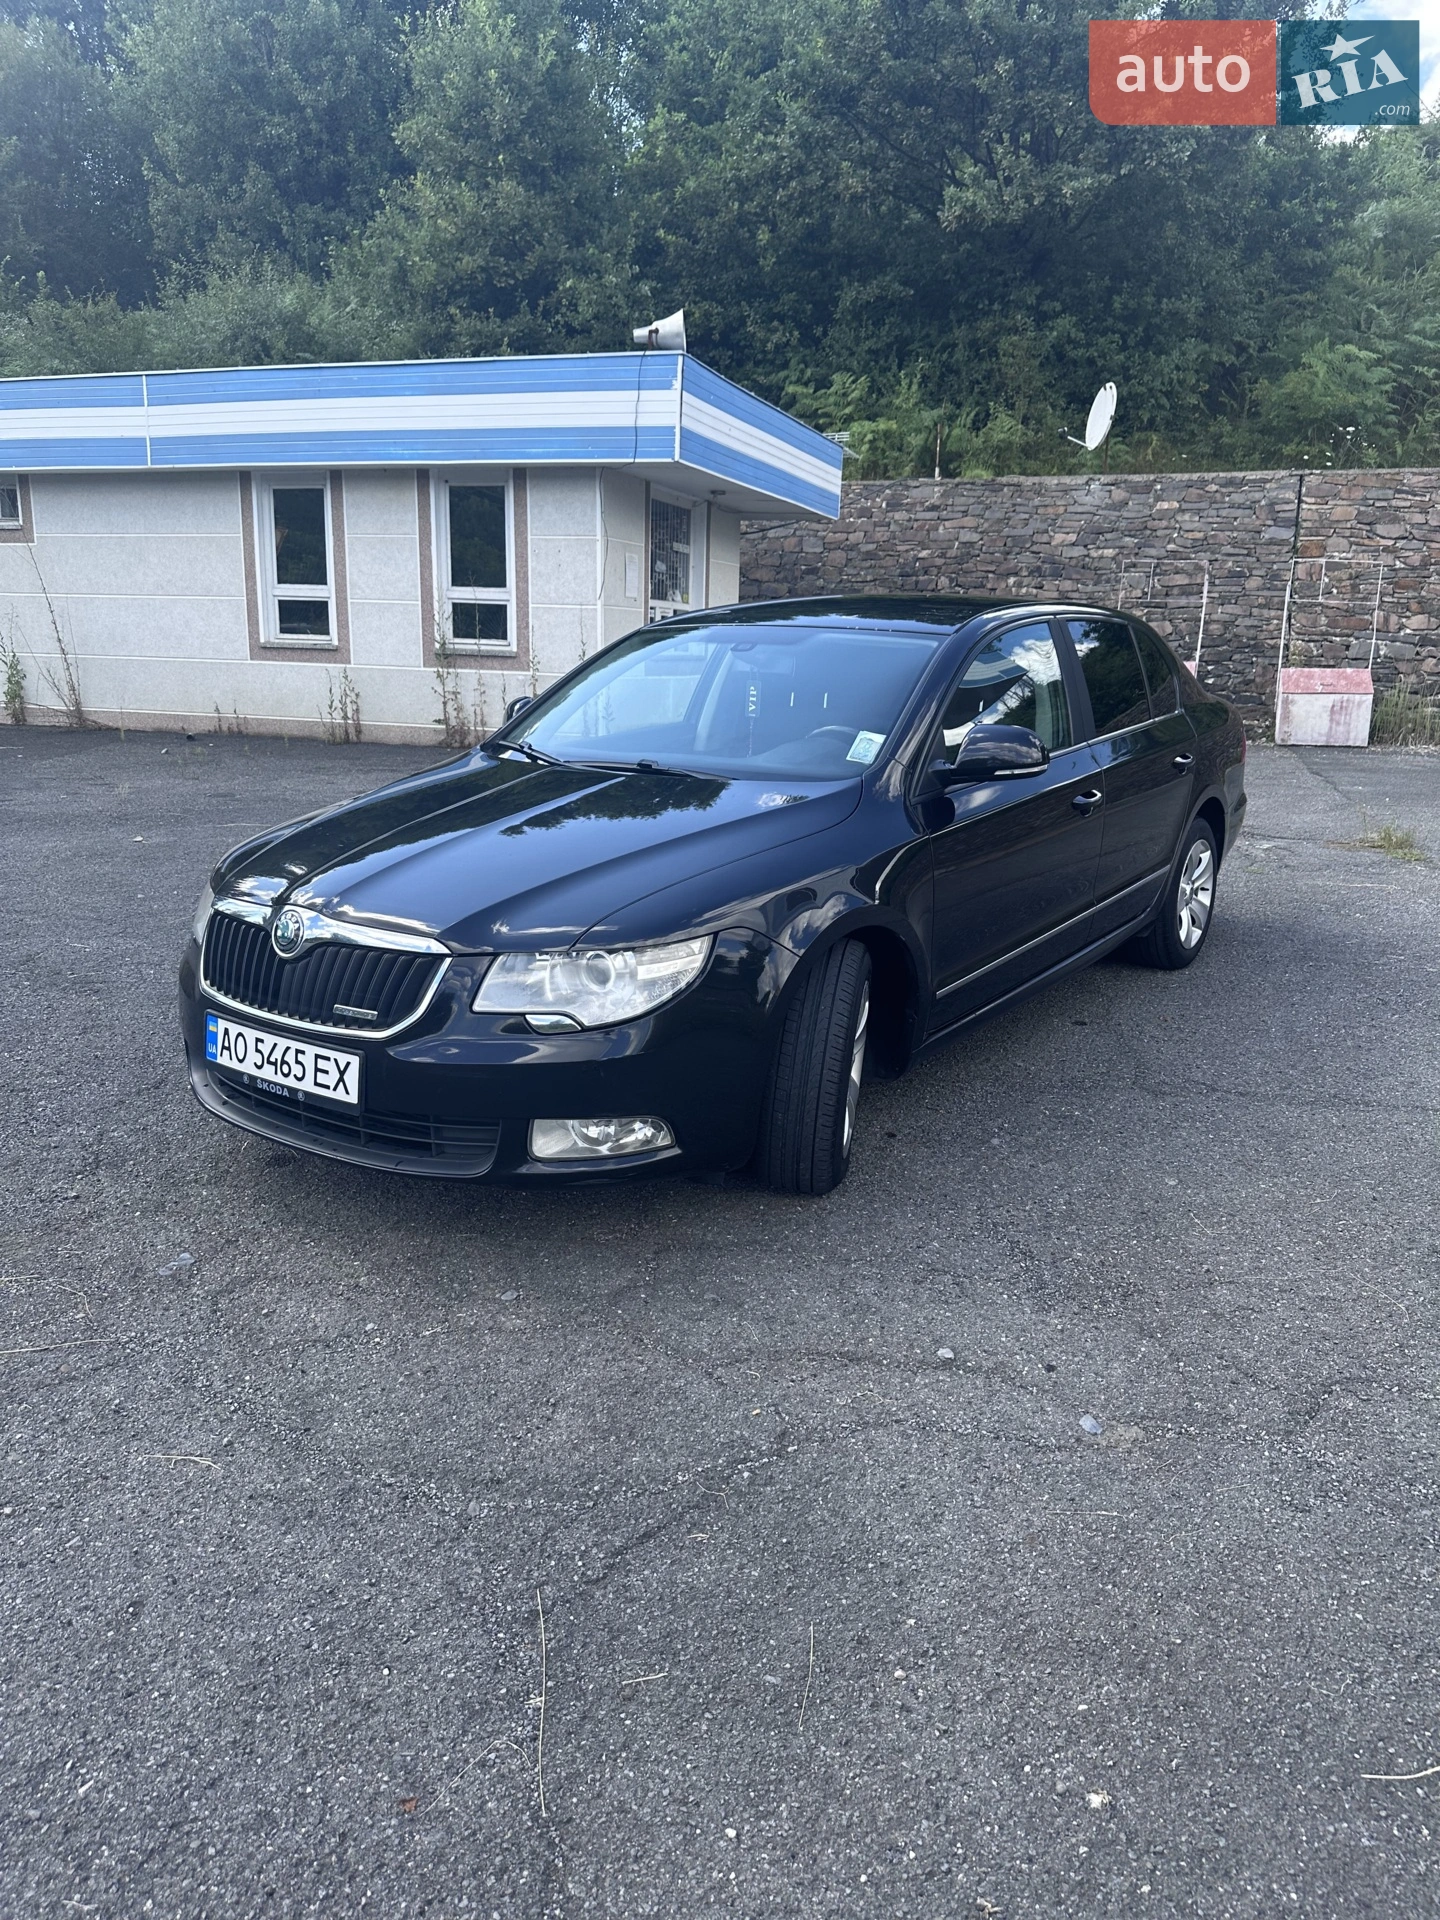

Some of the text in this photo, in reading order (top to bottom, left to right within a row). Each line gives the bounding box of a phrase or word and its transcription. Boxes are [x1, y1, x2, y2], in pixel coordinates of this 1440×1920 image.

[749, 686, 757, 712] VIP
[208, 1043, 217, 1055] UA
[220, 1027, 352, 1096] AO 5465 EX
